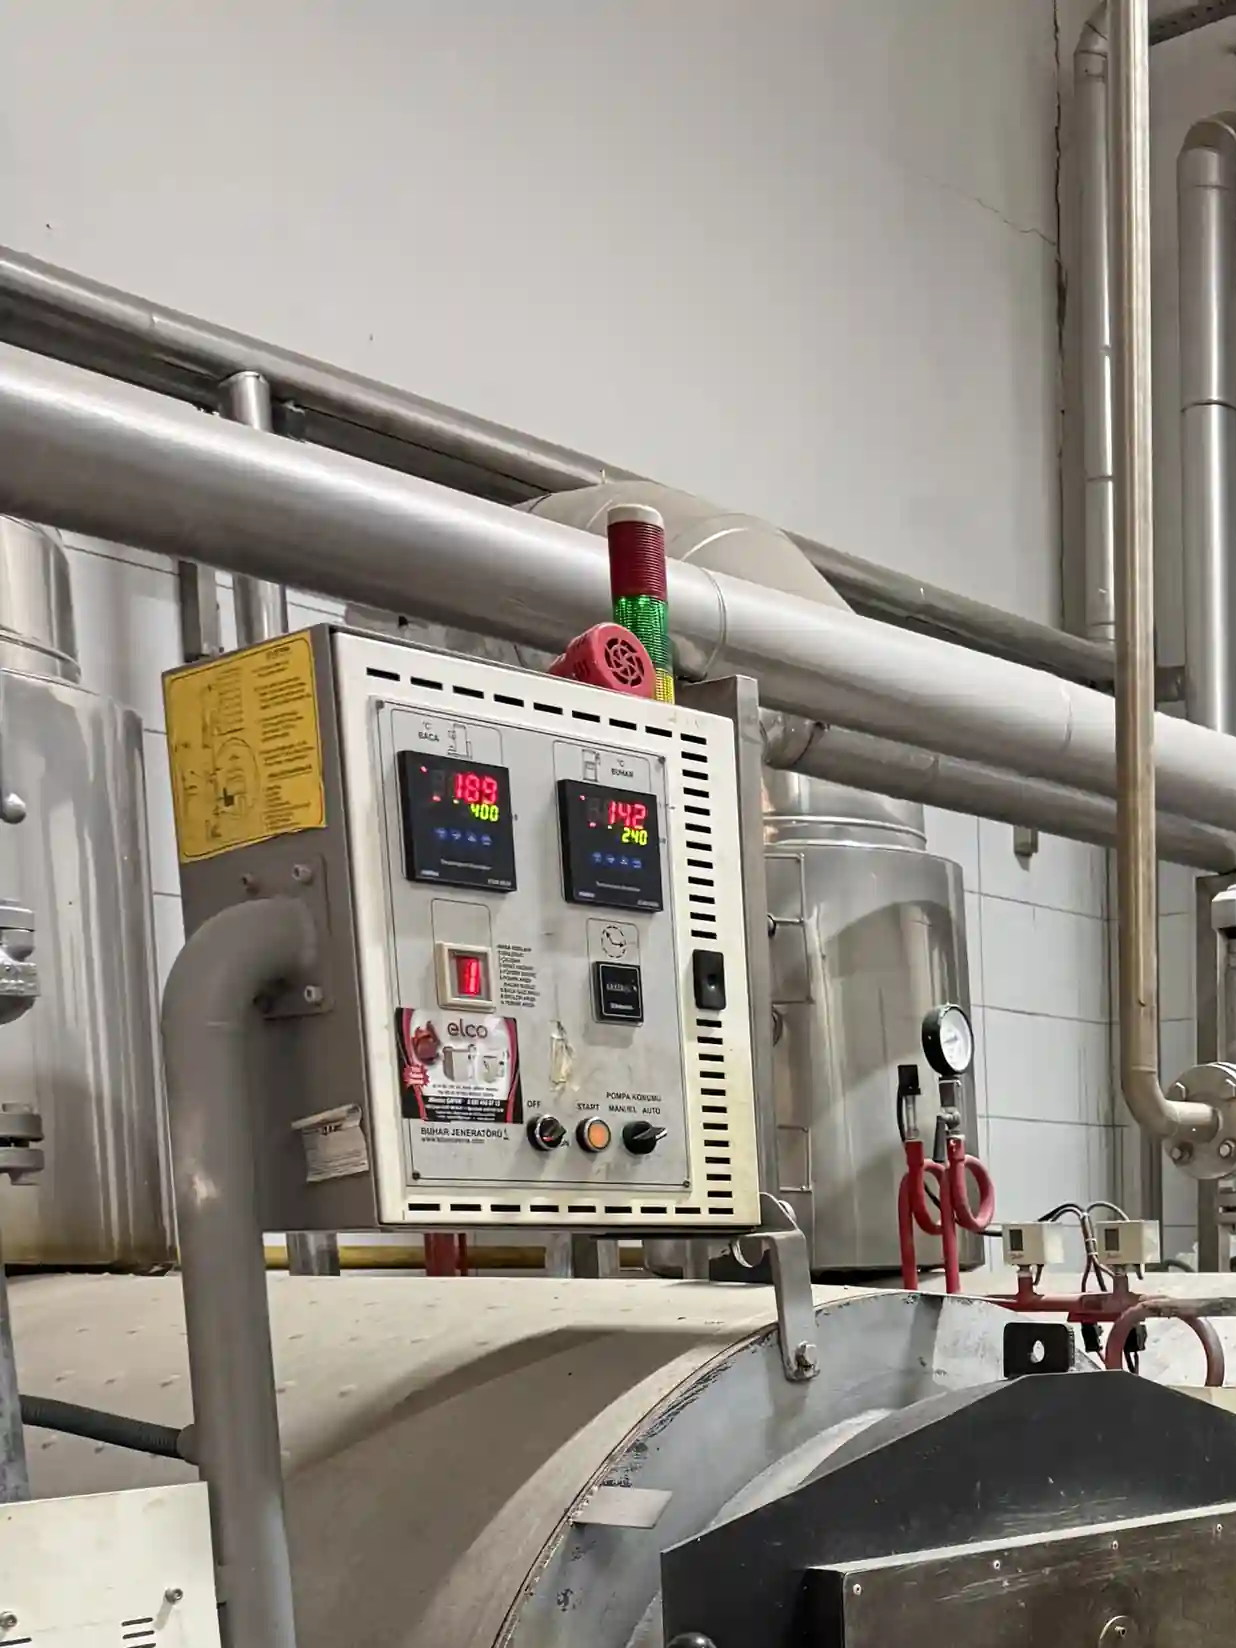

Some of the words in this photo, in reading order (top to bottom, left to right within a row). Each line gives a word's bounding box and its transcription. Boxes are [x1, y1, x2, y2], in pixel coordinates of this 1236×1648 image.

[470, 803, 500, 822] 400
[607, 799, 648, 830] 142
[621, 827, 648, 846] 240
[447, 1018, 488, 1039] elco
[606, 1091, 631, 1100] POMPA
[526, 1100, 541, 1108] OFF
[576, 1103, 600, 1111] START
[642, 1106, 661, 1115] AUTO
[420, 1127, 449, 1136] BUHAR
